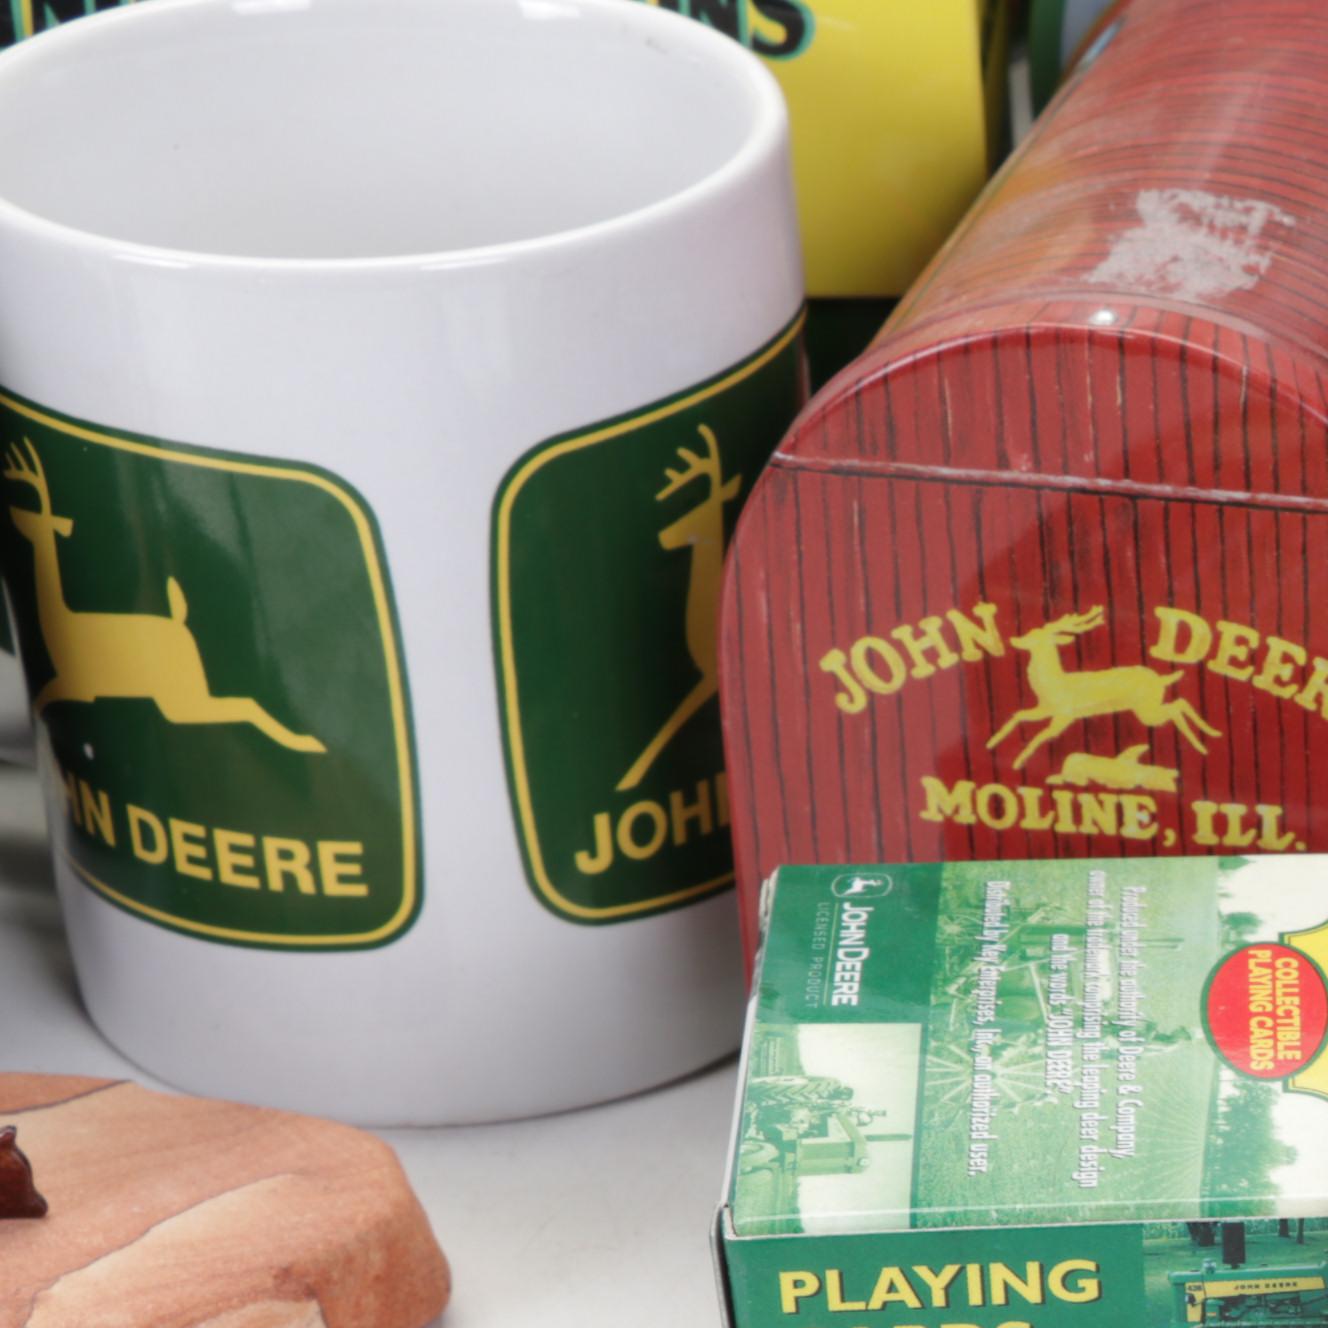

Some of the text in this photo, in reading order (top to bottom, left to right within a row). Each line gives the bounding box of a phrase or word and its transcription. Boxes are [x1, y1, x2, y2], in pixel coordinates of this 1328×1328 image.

[819, 602, 1006, 715] JOHN
[919, 776, 1308, 852] MOLINE, ILL.
[126, 803, 369, 897] DEERE
[805, 902, 830, 1008] LICENSED PRODUCT
[831, 902, 875, 1006] JOHN DEERE
[1120, 961, 1144, 976] the
[1047, 973, 1075, 1005] words
[1076, 982, 1107, 1038] comprising
[1112, 980, 1145, 1026] authority
[1247, 949, 1275, 1070] PLAYING CARDS
[1275, 957, 1302, 1061] COLLECTIBLE
[1082, 1042, 1110, 1060] the
[1119, 1031, 1144, 1042] of
[1073, 1064, 1110, 1109] leaping
[1118, 1047, 1143, 1080] Deere
[971, 1074, 999, 1139] authorized
[1117, 1085, 1142, 1094] &
[1080, 1113, 1108, 1141] deer
[1109, 1100, 1143, 1159] Company,
[968, 1144, 989, 1177] user.
[1072, 1145, 1107, 1188] design
[778, 1259, 1103, 1313] PLAYING
